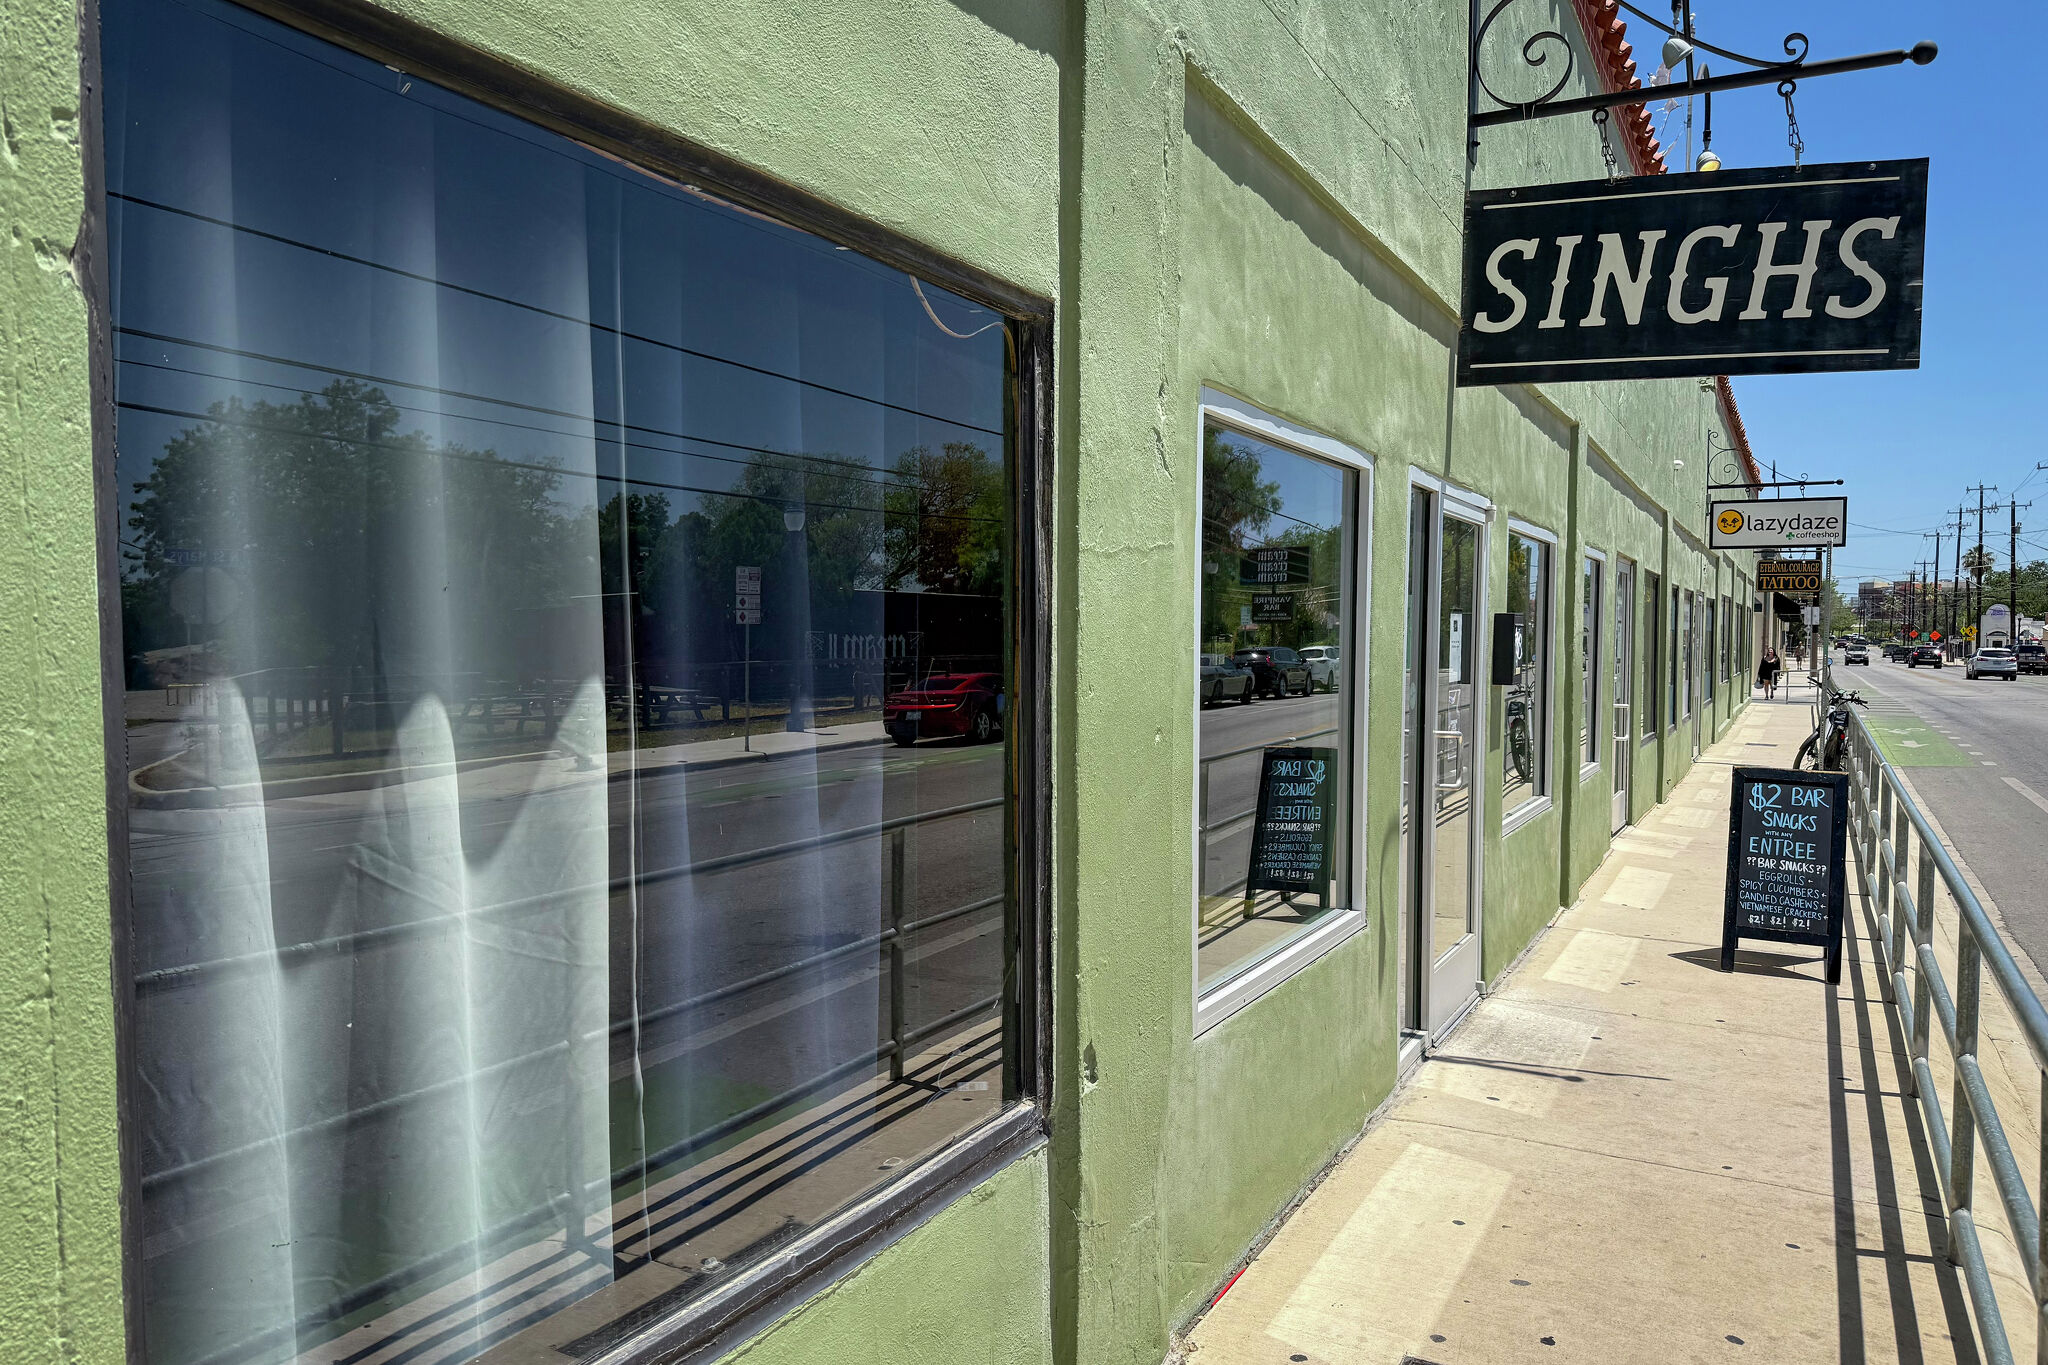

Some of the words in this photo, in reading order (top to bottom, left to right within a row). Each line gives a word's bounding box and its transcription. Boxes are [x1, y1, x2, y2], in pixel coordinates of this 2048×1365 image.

[1473, 215, 1901, 333] SINGHS
[1747, 513, 1839, 535] lazydaze
[1795, 531, 1840, 540] coffeeshop
[1759, 563, 1788, 573] ETERNAL
[1788, 563, 1820, 573] COURAGE
[1759, 576, 1819, 590] TATTOO
[1748, 782, 1782, 812] $2
[1791, 786, 1830, 808] BAR
[1761, 809, 1818, 832] SNACKS
[1780, 831, 1793, 839] ANY
[1749, 836, 1817, 860] ENTREE
[1759, 870, 1806, 886] EGGROLLS
[1739, 878, 1764, 891] SPICY
[1767, 882, 1820, 899] CUCUMBERS
[1739, 890, 1778, 905] CANDIED
[1779, 895, 1820, 911] CASHEWS
[1739, 901, 1783, 914] VIETNAMESE
[1784, 907, 1822, 921] CRACKERS
[1748, 914, 1765, 925] $2!
[1770, 915, 1786, 928] $2!
[1791, 917, 1810, 930] $2!
